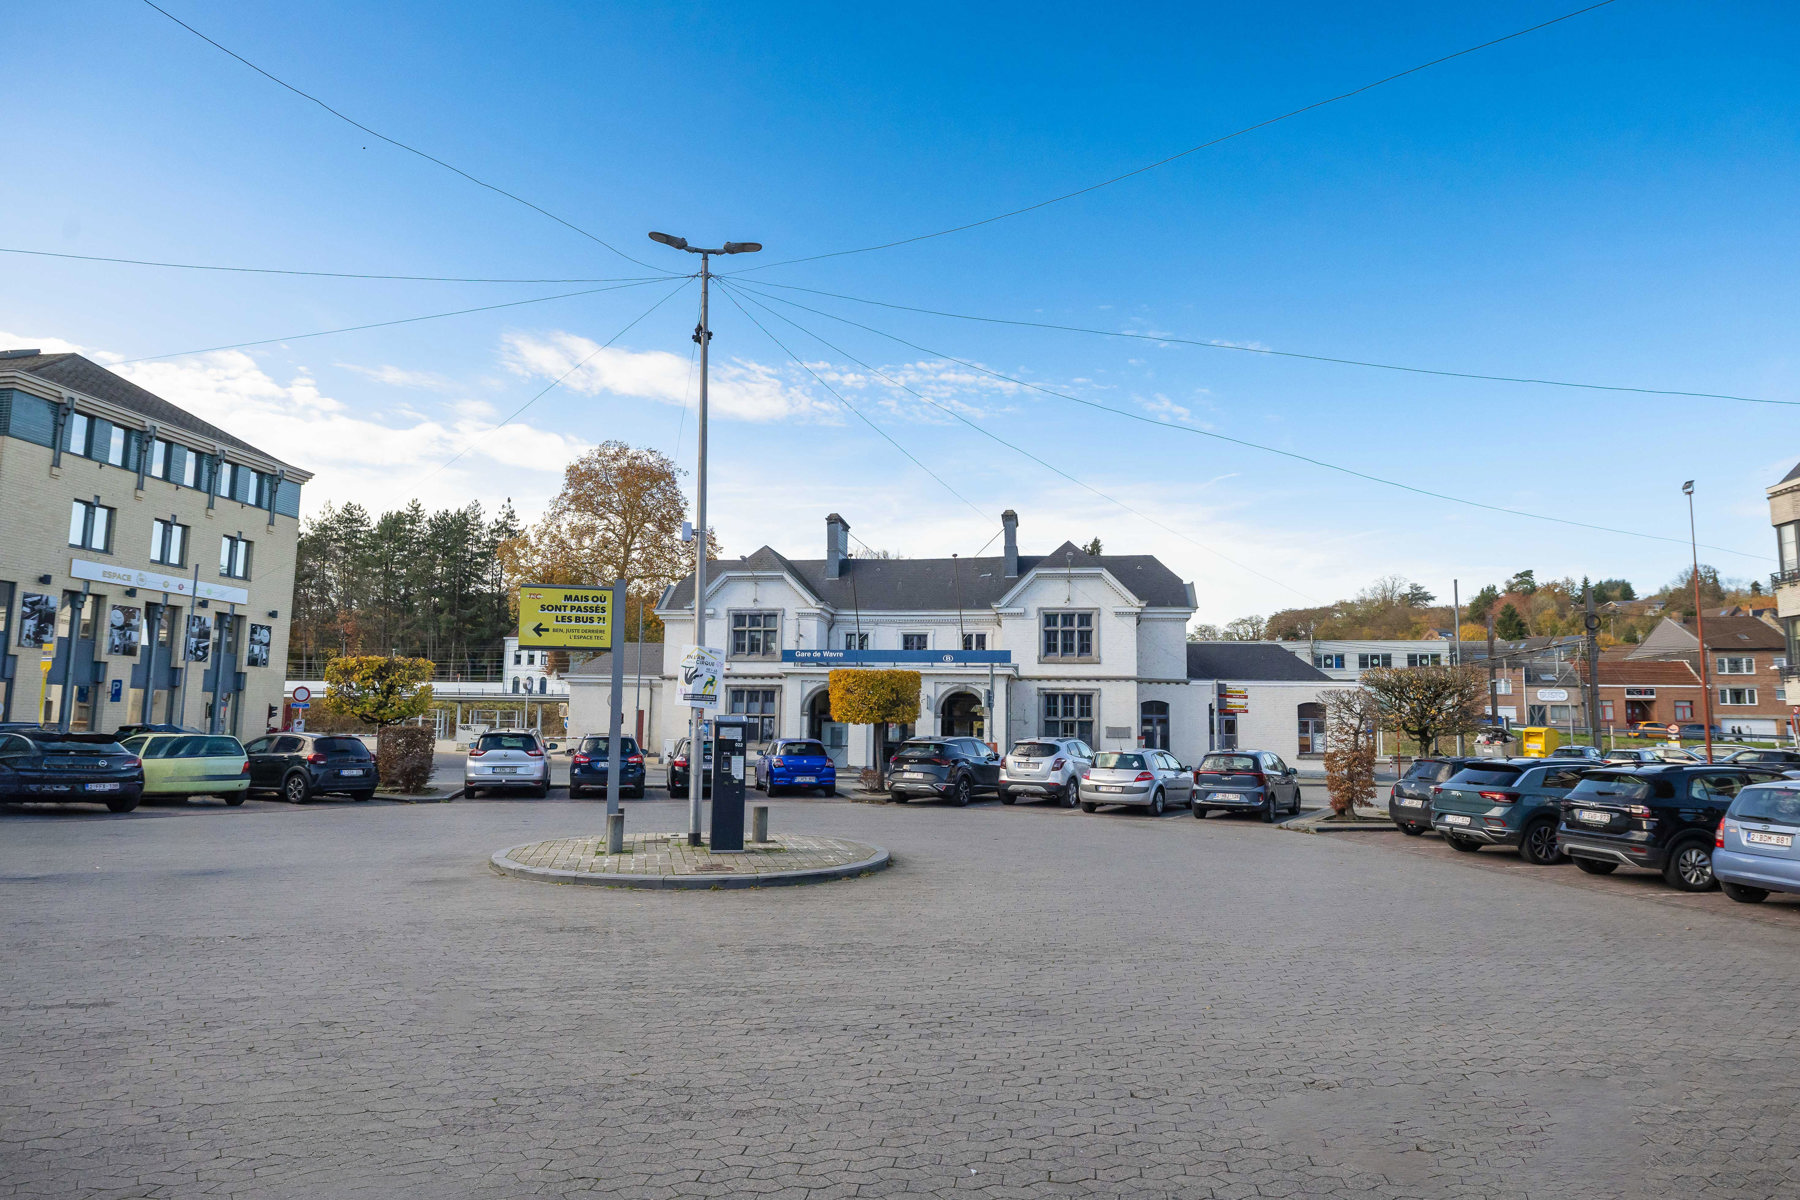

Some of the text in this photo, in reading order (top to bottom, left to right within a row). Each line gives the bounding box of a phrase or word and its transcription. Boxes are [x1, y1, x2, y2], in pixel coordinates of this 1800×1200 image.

[102, 571, 132, 582] ESPACE
[564, 594, 606, 603] MAIS OÙ
[540, 604, 606, 614] SONT PASSÉS
[112, 682, 120, 694] P
